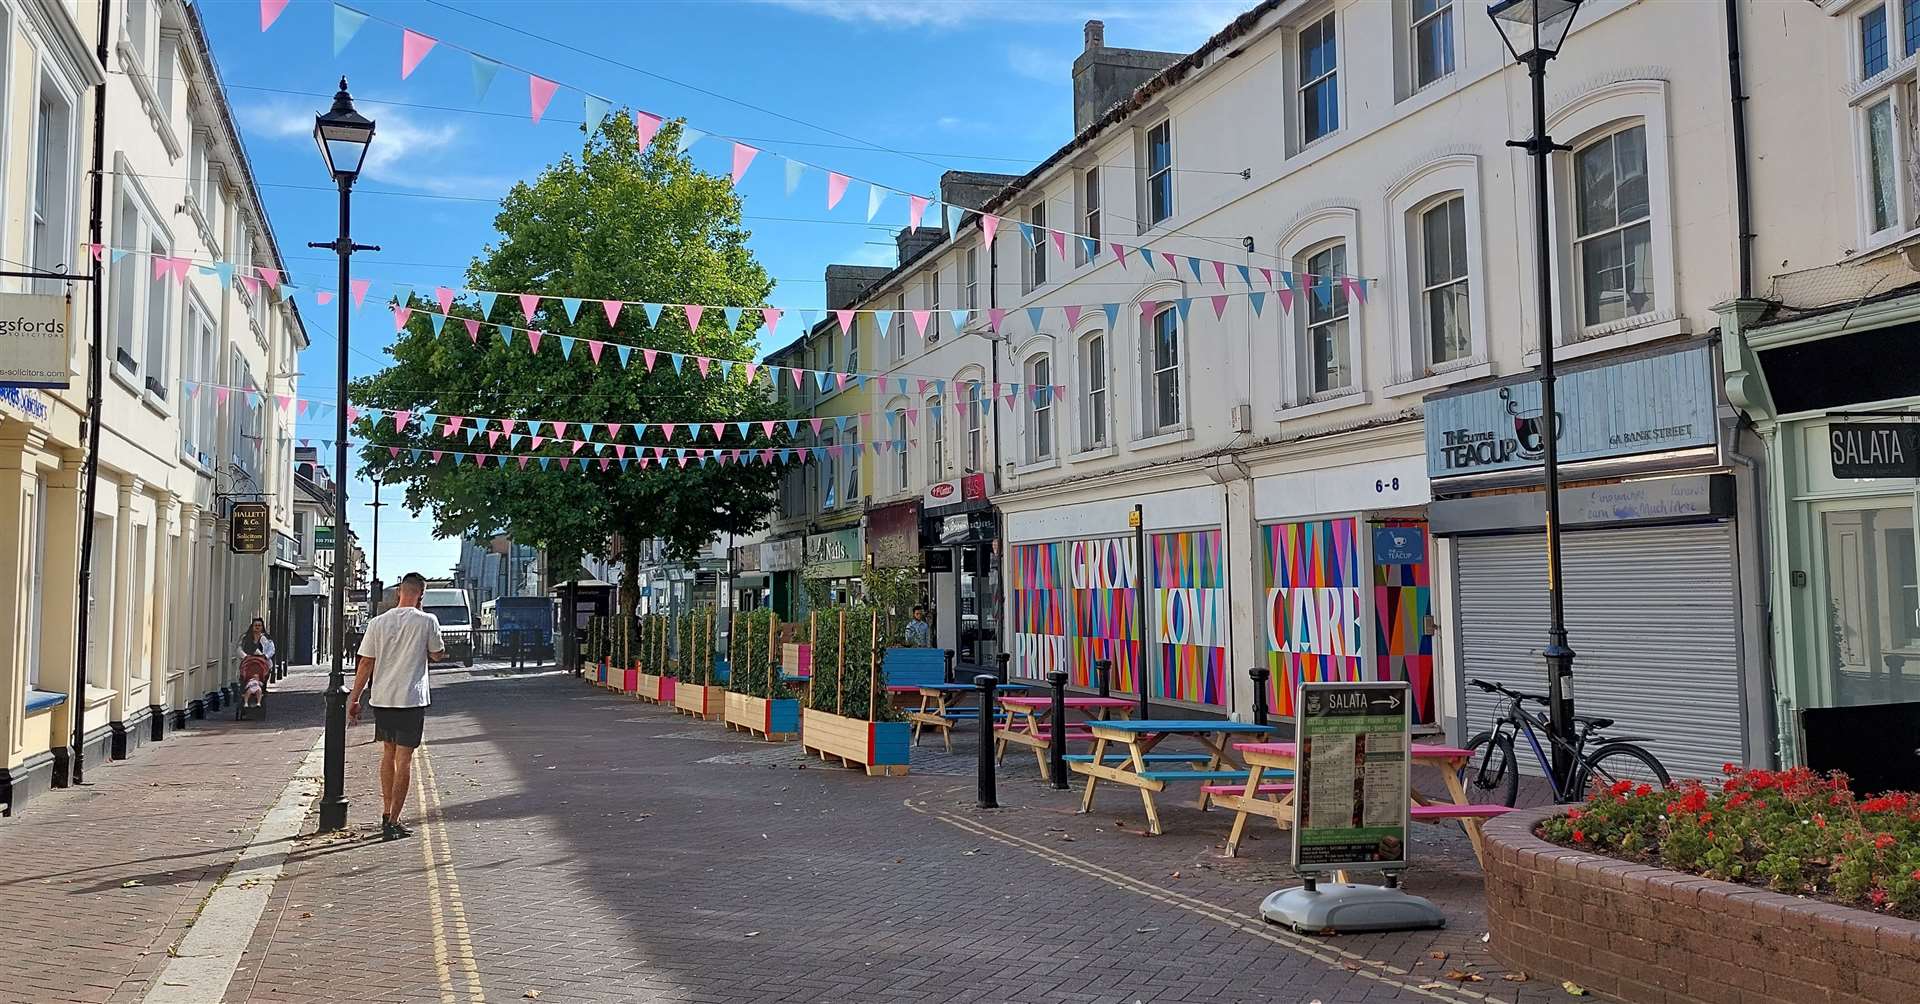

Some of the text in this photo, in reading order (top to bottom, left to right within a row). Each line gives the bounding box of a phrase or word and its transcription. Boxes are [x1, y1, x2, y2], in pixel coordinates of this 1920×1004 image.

[1443, 428, 1468, 446] THE
[1624, 430, 1651, 442] BANK
[1653, 424, 1692, 440] STREET
[1440, 438, 1517, 469] TEACUP
[1832, 430, 1904, 464] SALATA
[1329, 693, 1368, 709] SALATA
